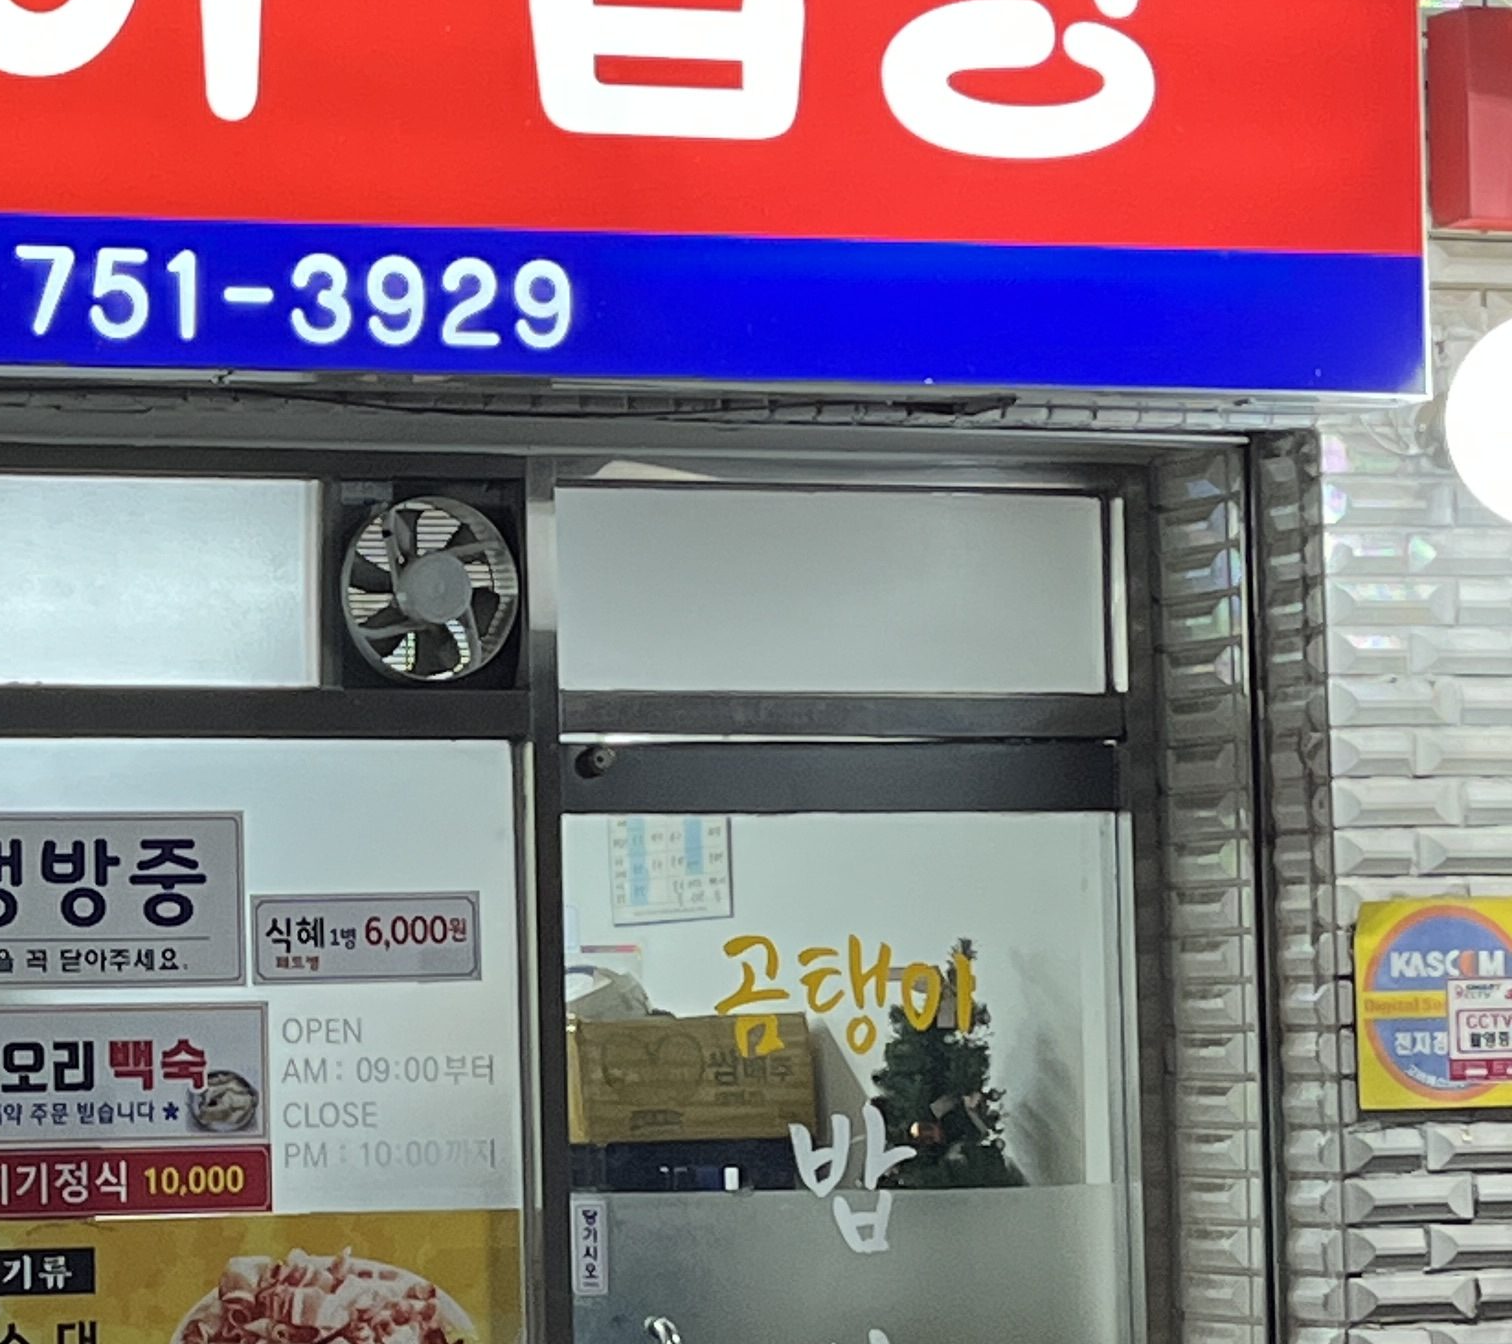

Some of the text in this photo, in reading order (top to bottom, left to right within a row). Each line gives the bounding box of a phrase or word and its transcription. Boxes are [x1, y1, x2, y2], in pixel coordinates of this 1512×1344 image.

[14, 243, 574, 349] 751-3929
[265, 917, 326, 953] 식혜
[330, 927, 357, 950] 1병
[25, 949, 49, 973] 꼭
[60, 947, 188, 973] 닫아주세요.
[714, 933, 977, 1056] 곰탱이
[282, 1017, 363, 1044] OPEN
[1465, 1014, 1512, 1030] CCTV
[107, 1038, 208, 1091] 백숙
[29, 1103, 69, 1126] 주문
[282, 1101, 378, 1129] CLOSE
[144, 1165, 245, 1197] 10,000
